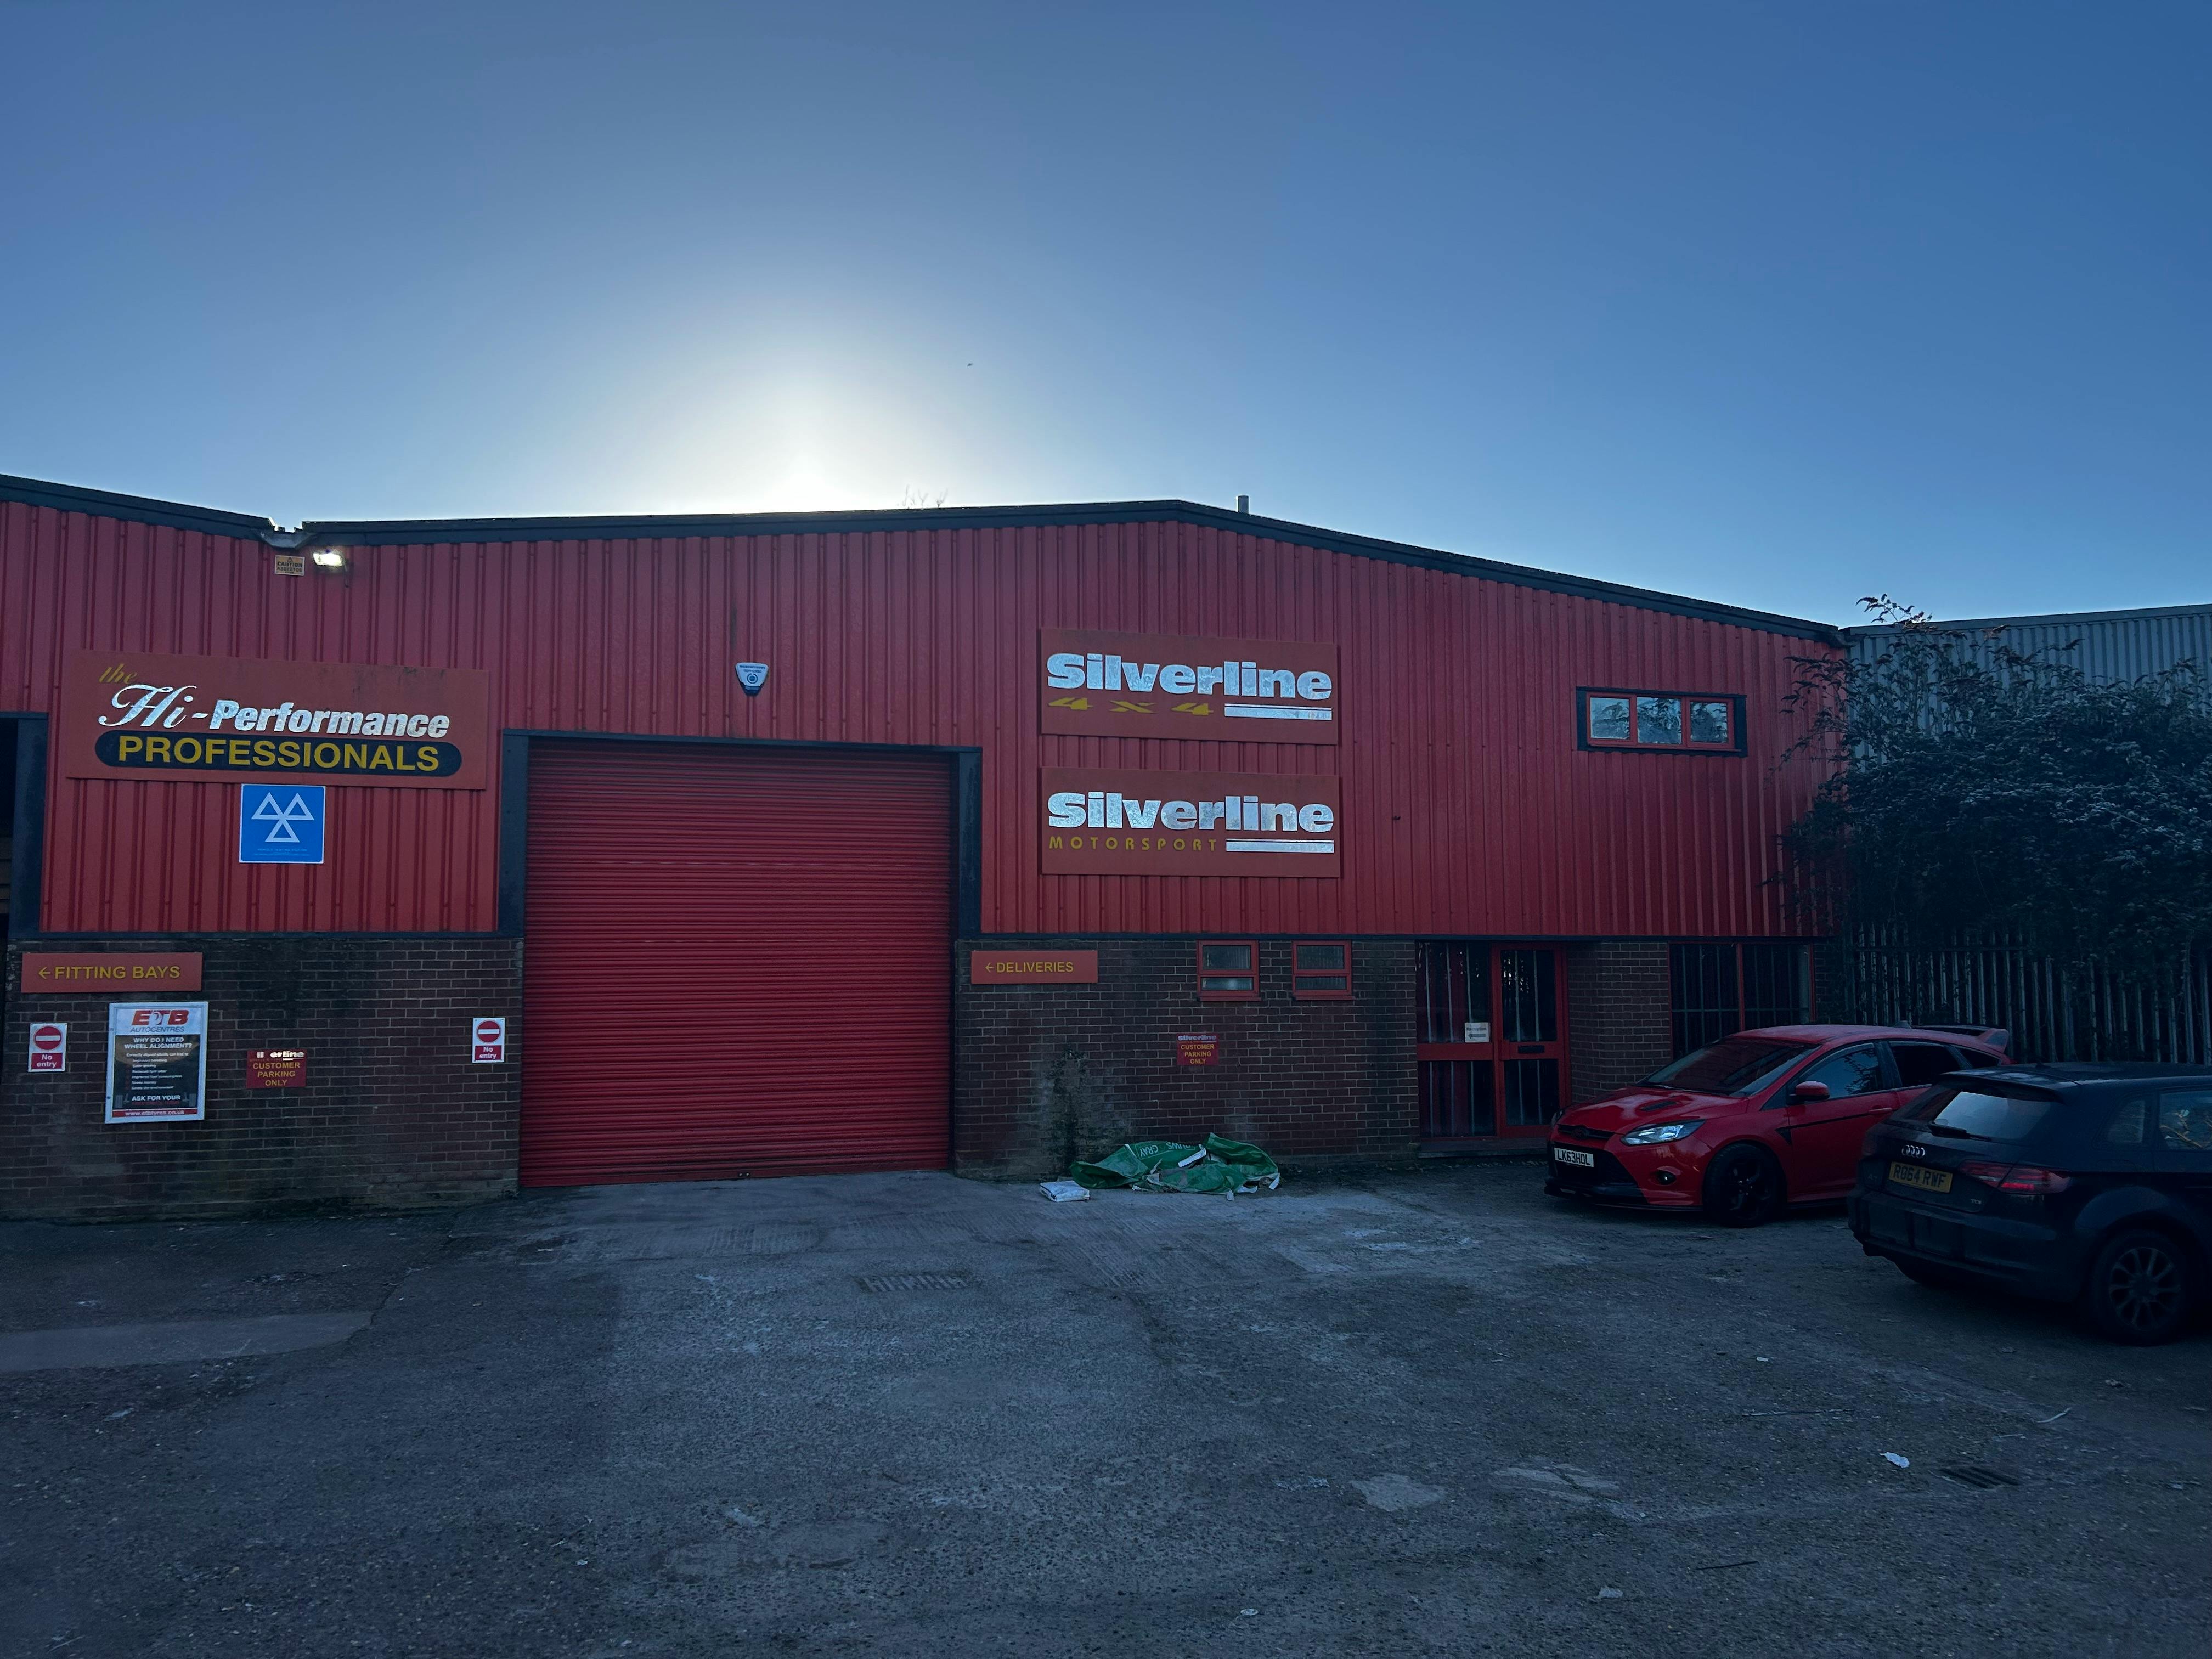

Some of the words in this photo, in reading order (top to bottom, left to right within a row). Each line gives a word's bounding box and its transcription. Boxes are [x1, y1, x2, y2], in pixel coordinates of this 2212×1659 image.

[98, 663, 138, 684] the
[1046, 653, 1333, 701] Silverline
[98, 684, 450, 738] Hi-Performance
[119, 735, 439, 772] PROFESSIONALS
[1047, 791, 1334, 833] Silverline
[1049, 836, 1217, 852] MOTORSPORT
[54, 966, 127, 979] FITTING
[132, 966, 180, 979] BAYS
[996, 962, 1074, 973] DELIVERIES
[132, 1009, 189, 1025] ETB
[1922, 1171, 1946, 1187] RWF
